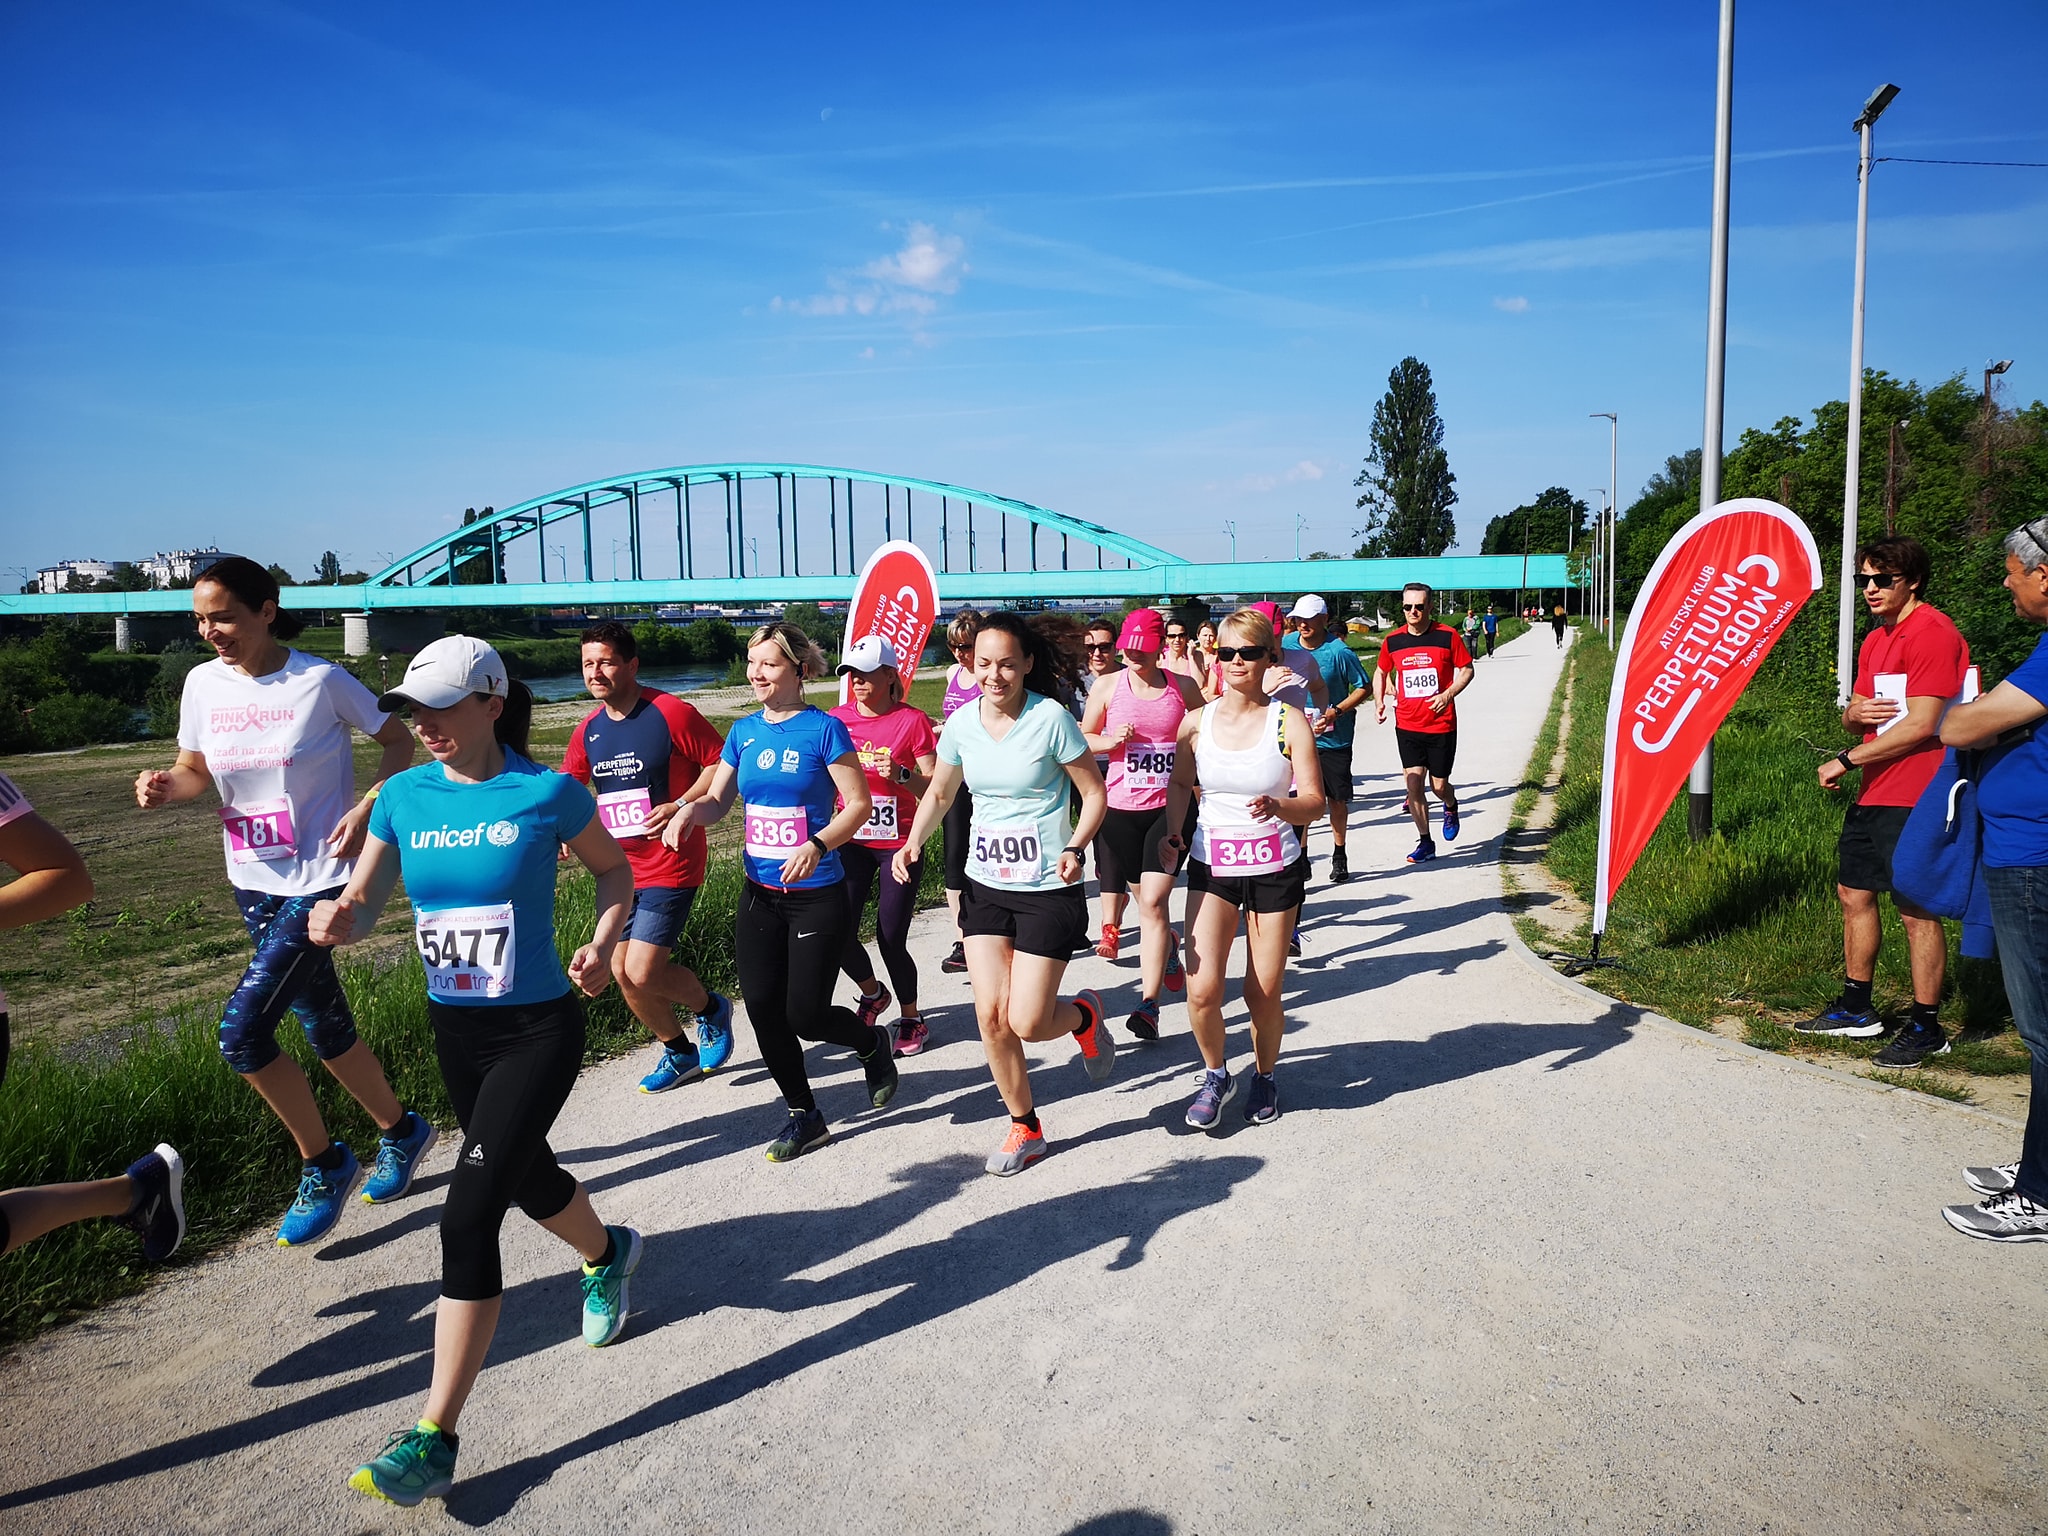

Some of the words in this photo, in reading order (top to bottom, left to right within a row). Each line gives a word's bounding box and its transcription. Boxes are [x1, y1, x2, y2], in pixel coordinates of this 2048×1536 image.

[869, 618, 881, 636] SKI
[875, 593, 888, 620] KLUB
[1659, 595, 1699, 650] ATLETSKI
[1691, 565, 1716, 597] KLUB
[1763, 601, 1793, 634] Croatia
[1634, 572, 1747, 723] PERPETUUM
[1691, 586, 1777, 690] MOBILE
[1405, 674, 1437, 689] 5488
[211, 711, 246, 724] PINK
[260, 709, 295, 721] RUN
[242, 748, 255, 756] na
[257, 744, 280, 755] zrak
[283, 743, 287, 754] i
[1127, 752, 1175, 773] 5489
[597, 757, 635, 770] PERPETUUM
[1128, 777, 1147, 785] run
[1156, 776, 1169, 785] tre
[605, 801, 645, 827] 166
[868, 805, 895, 827] 93
[237, 815, 279, 848] 181
[411, 822, 487, 849] unicef
[751, 818, 798, 846] 336
[976, 836, 1038, 864] 5490
[1219, 839, 1273, 865] 346
[454, 915, 484, 924] ATLETSKI
[486, 912, 509, 922] SAVEZ
[419, 926, 510, 969] 5477
[472, 972, 507, 990] trek
